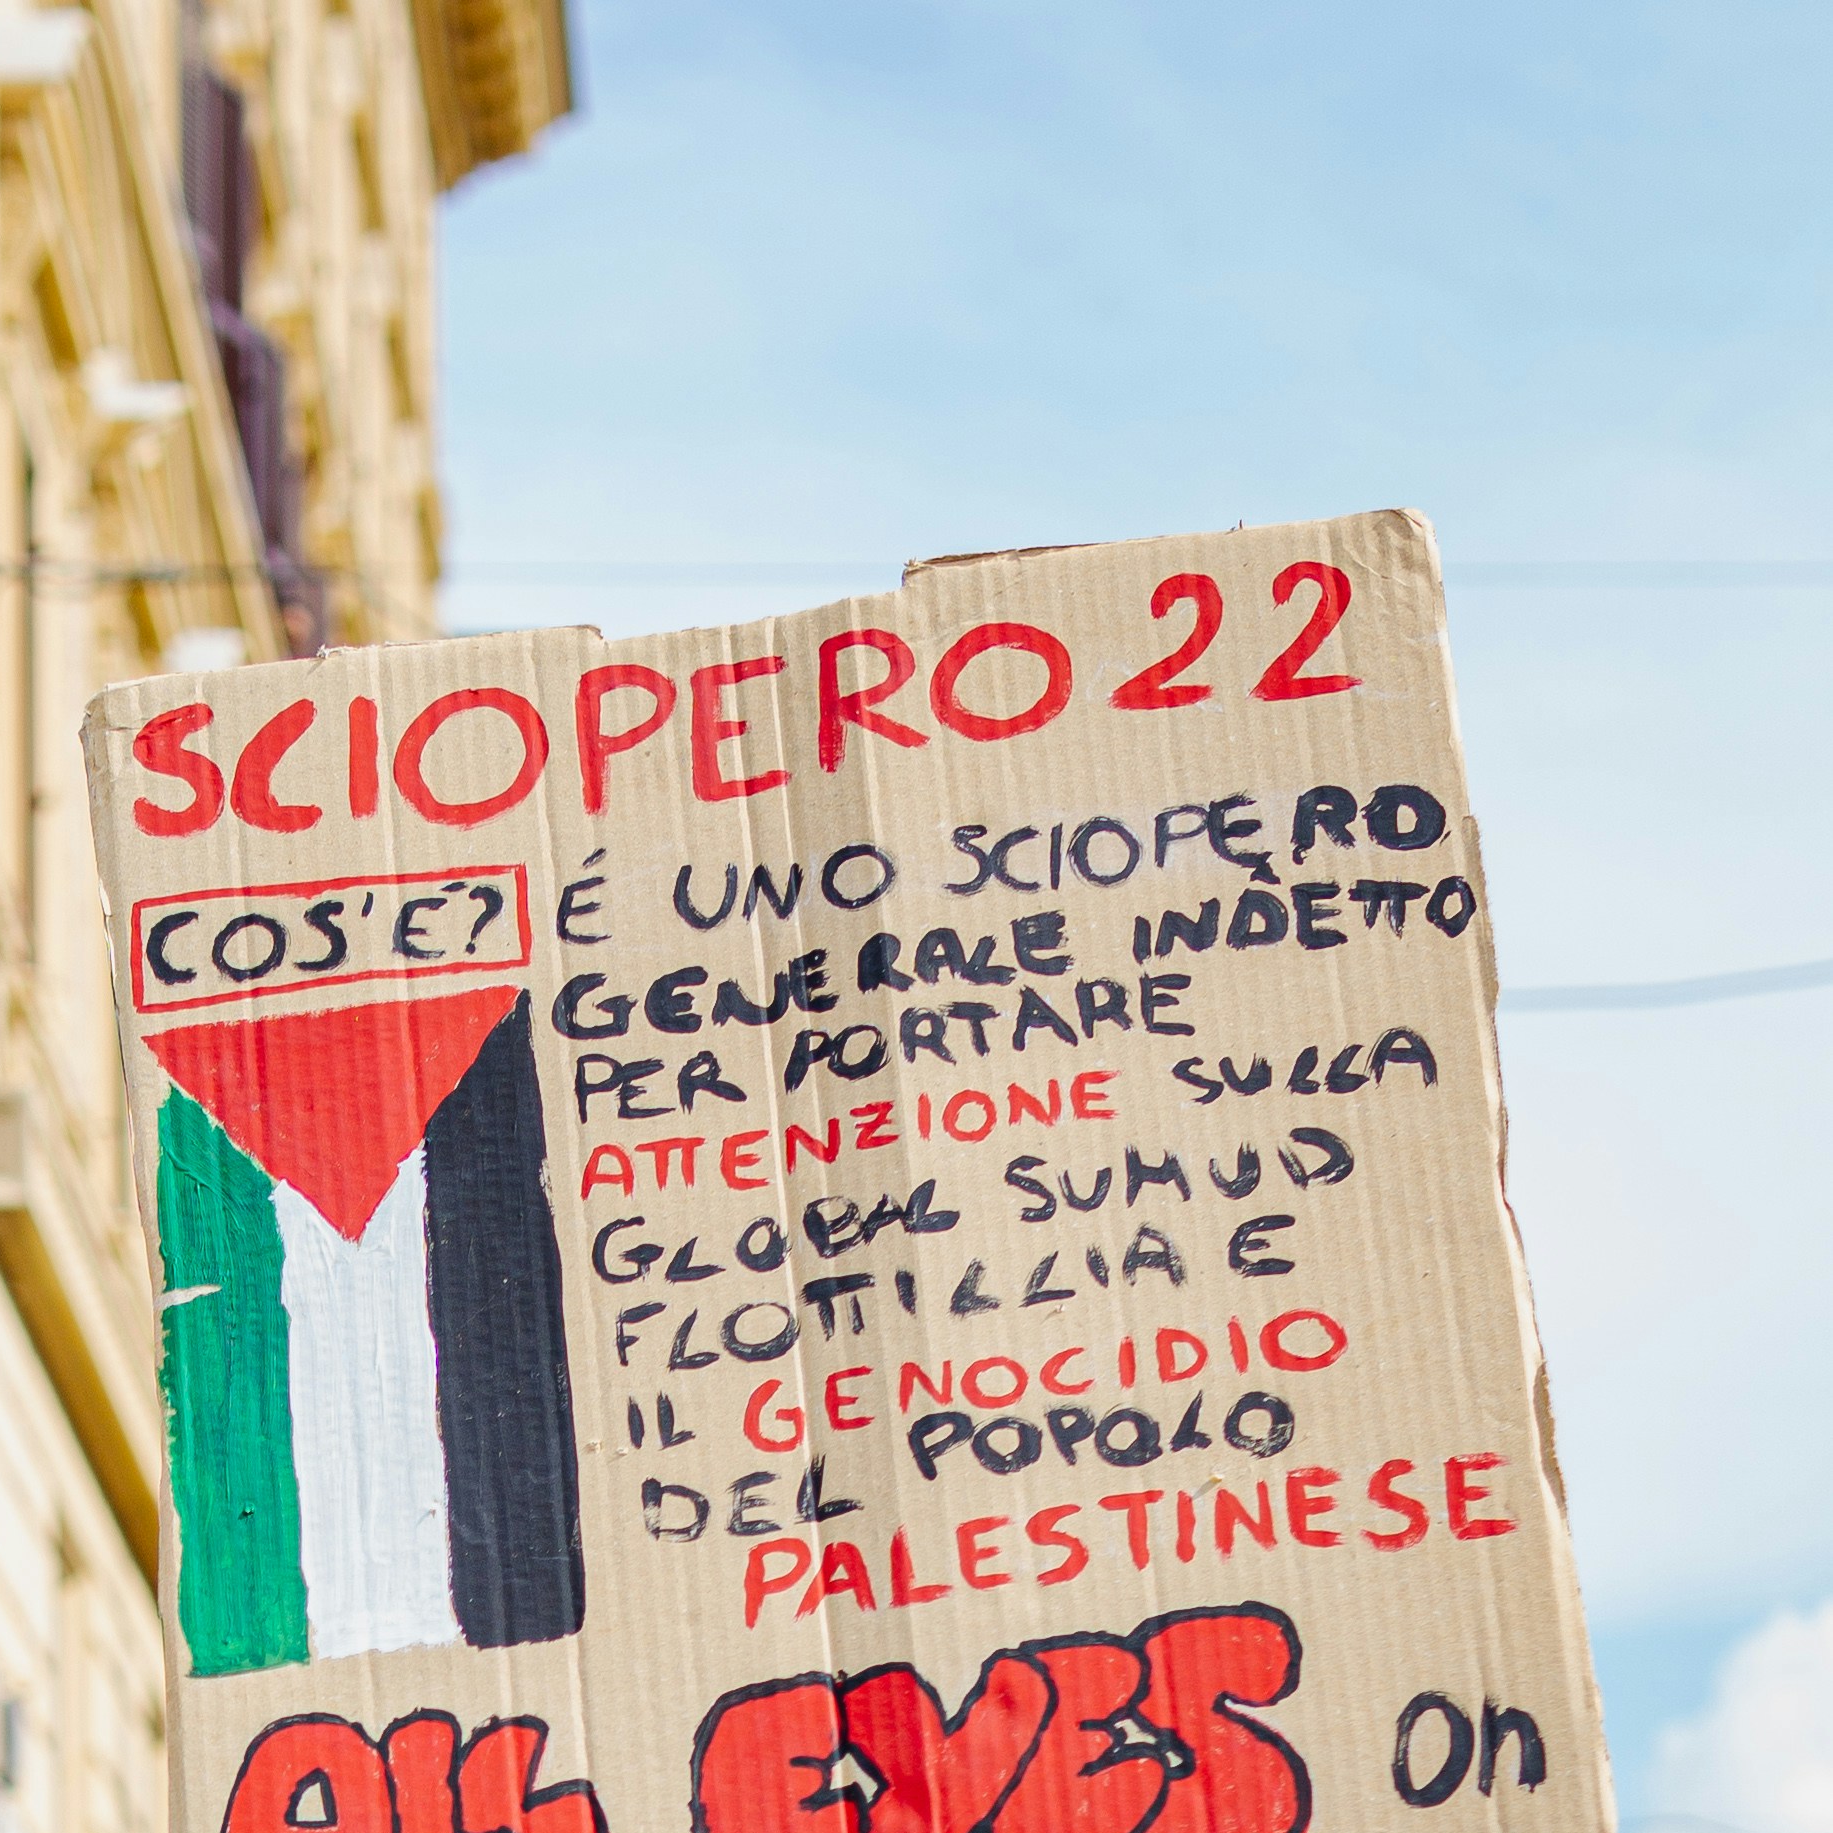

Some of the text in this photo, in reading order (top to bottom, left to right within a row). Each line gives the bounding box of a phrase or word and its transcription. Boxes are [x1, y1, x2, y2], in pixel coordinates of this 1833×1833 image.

[131, 560, 1363, 837] SCIOPERO 22
[672, 842, 896, 931] UNO
[942, 783, 1452, 896] SCIOPERO
[551, 874, 1477, 1041] GENERALE INDETTO
[574, 972, 1196, 1124] PER PORTARE
[580, 1026, 1439, 1201] ATTENZIONE SULLA
[591, 1127, 1355, 1284] GLOBAL SUMUD
[1226, 1214, 1297, 1278] E
[626, 1308, 1349, 1453] IL GENOCIDIO
[640, 1390, 1295, 1543] DEL POPOLO
[743, 1451, 1518, 1630] PALESTINESE
